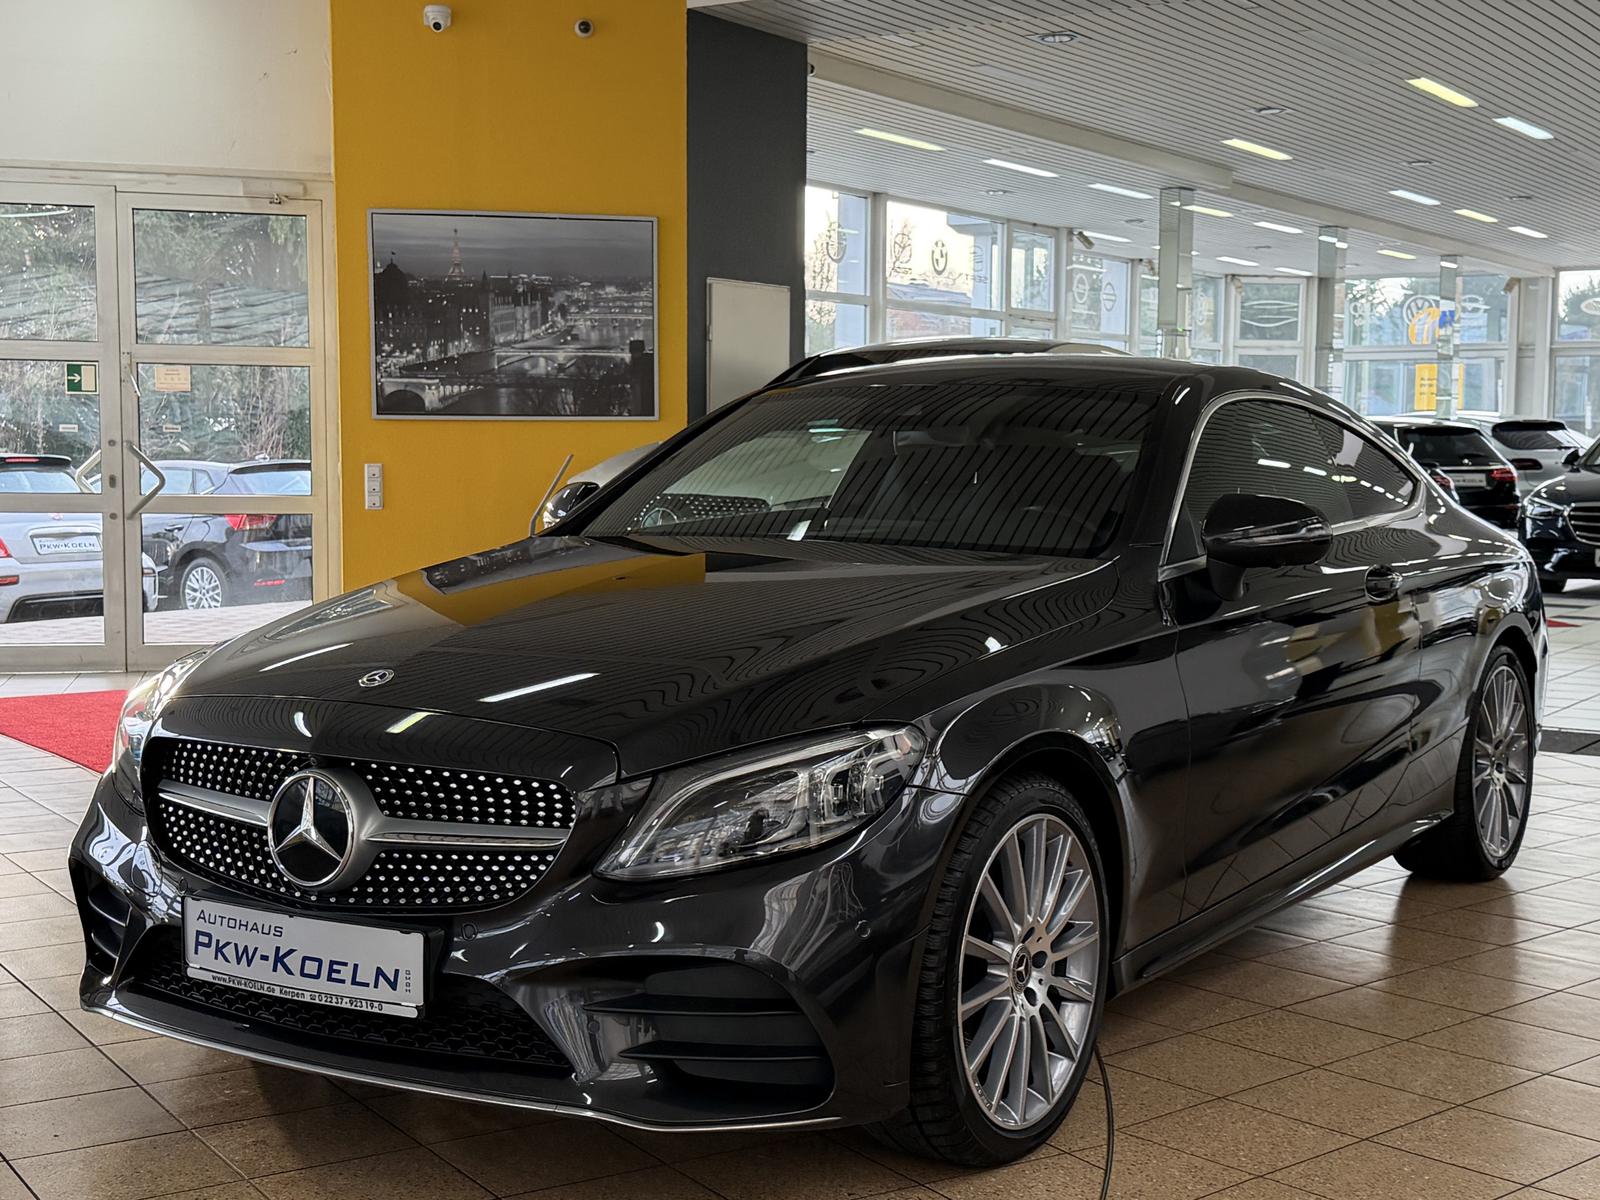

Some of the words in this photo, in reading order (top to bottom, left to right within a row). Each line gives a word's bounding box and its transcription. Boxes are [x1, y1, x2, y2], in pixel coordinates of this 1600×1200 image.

[196, 909, 284, 938] AUTOHAUS
[193, 929, 400, 992] PKW-KOELN
[279, 987, 306, 1000] Kerpen
